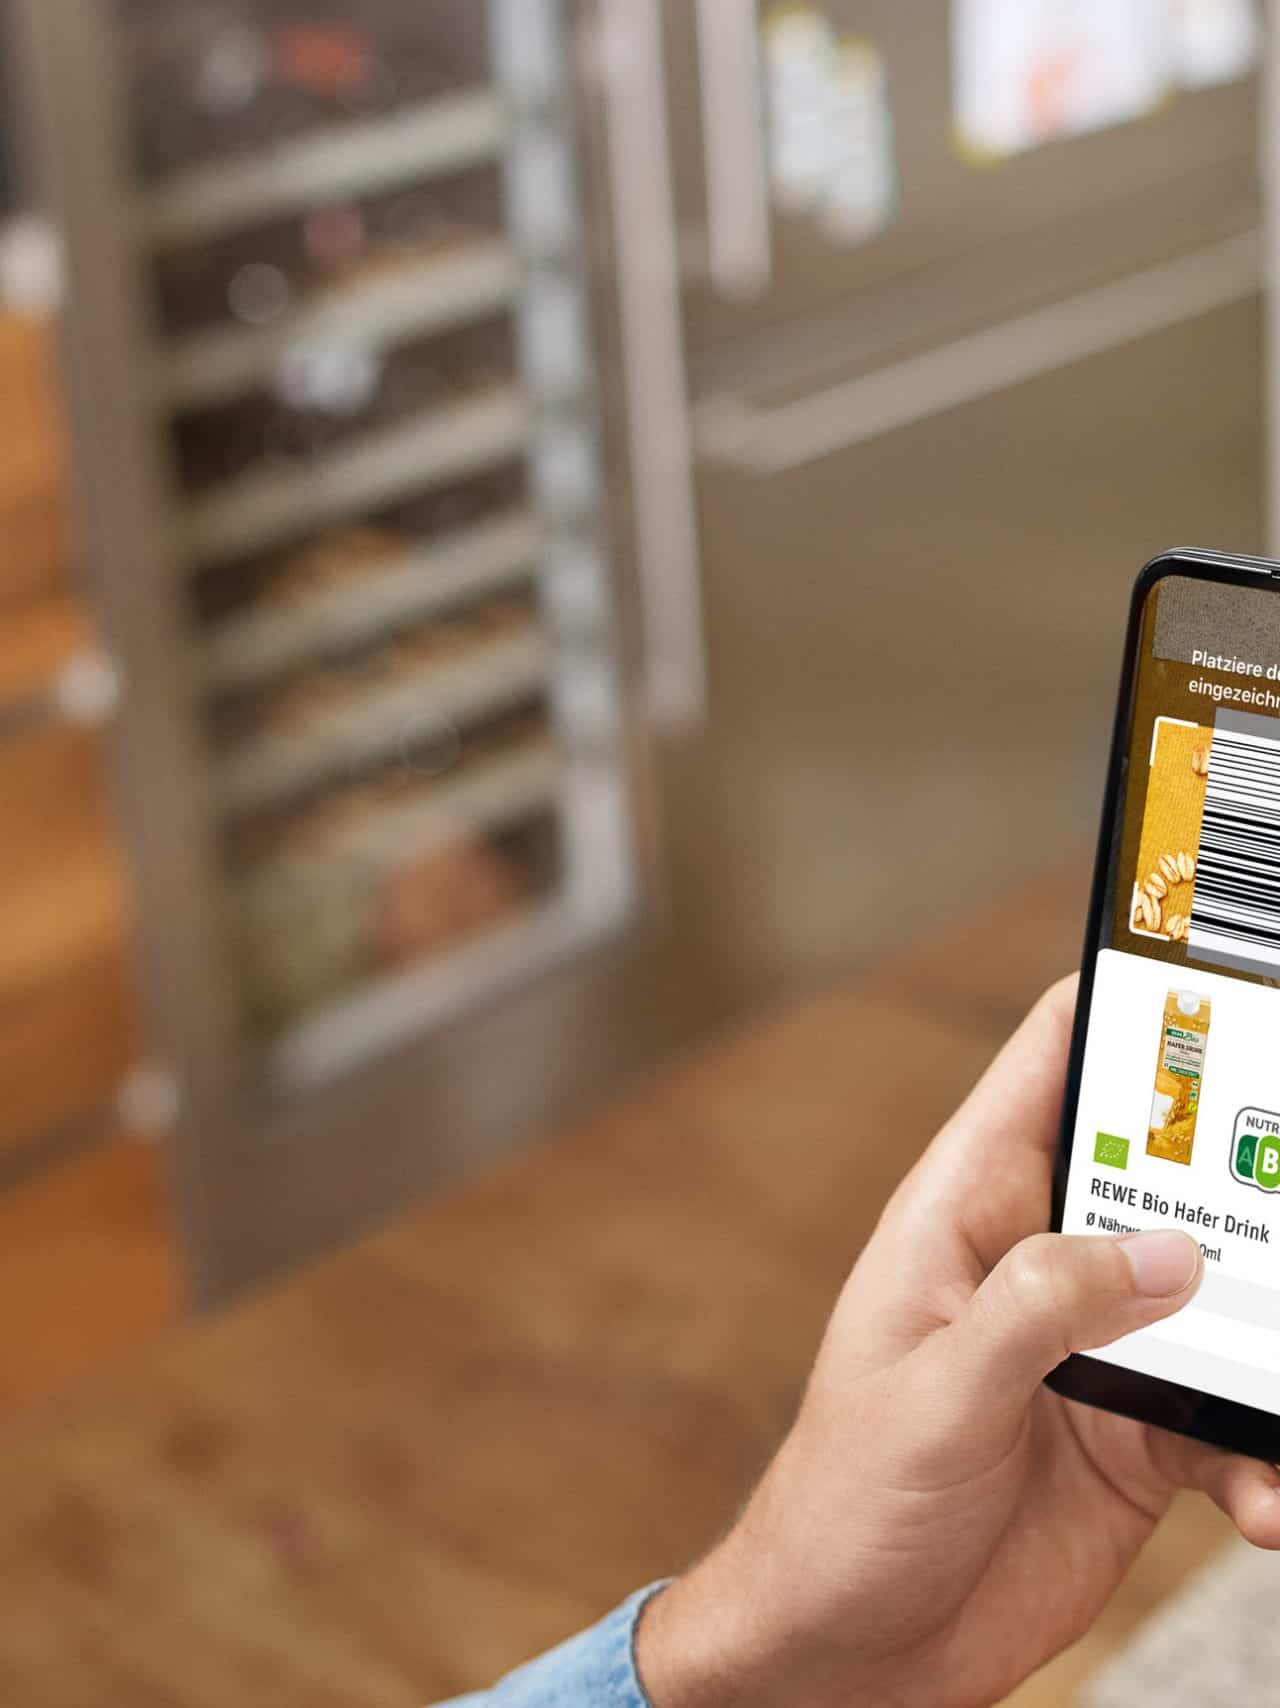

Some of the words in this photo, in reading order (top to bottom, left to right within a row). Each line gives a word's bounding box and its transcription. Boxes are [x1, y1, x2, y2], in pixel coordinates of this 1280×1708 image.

[1192, 650, 1263, 678] Platziere
[1086, 1212, 1096, 1226] Ø
[1098, 1215, 1141, 1233] Nährw
[1090, 1178, 1138, 1207] REWE
[1142, 1192, 1169, 1215] Bio
[1174, 1200, 1219, 1229] Hafer
[1224, 1214, 1270, 1243] Drink
